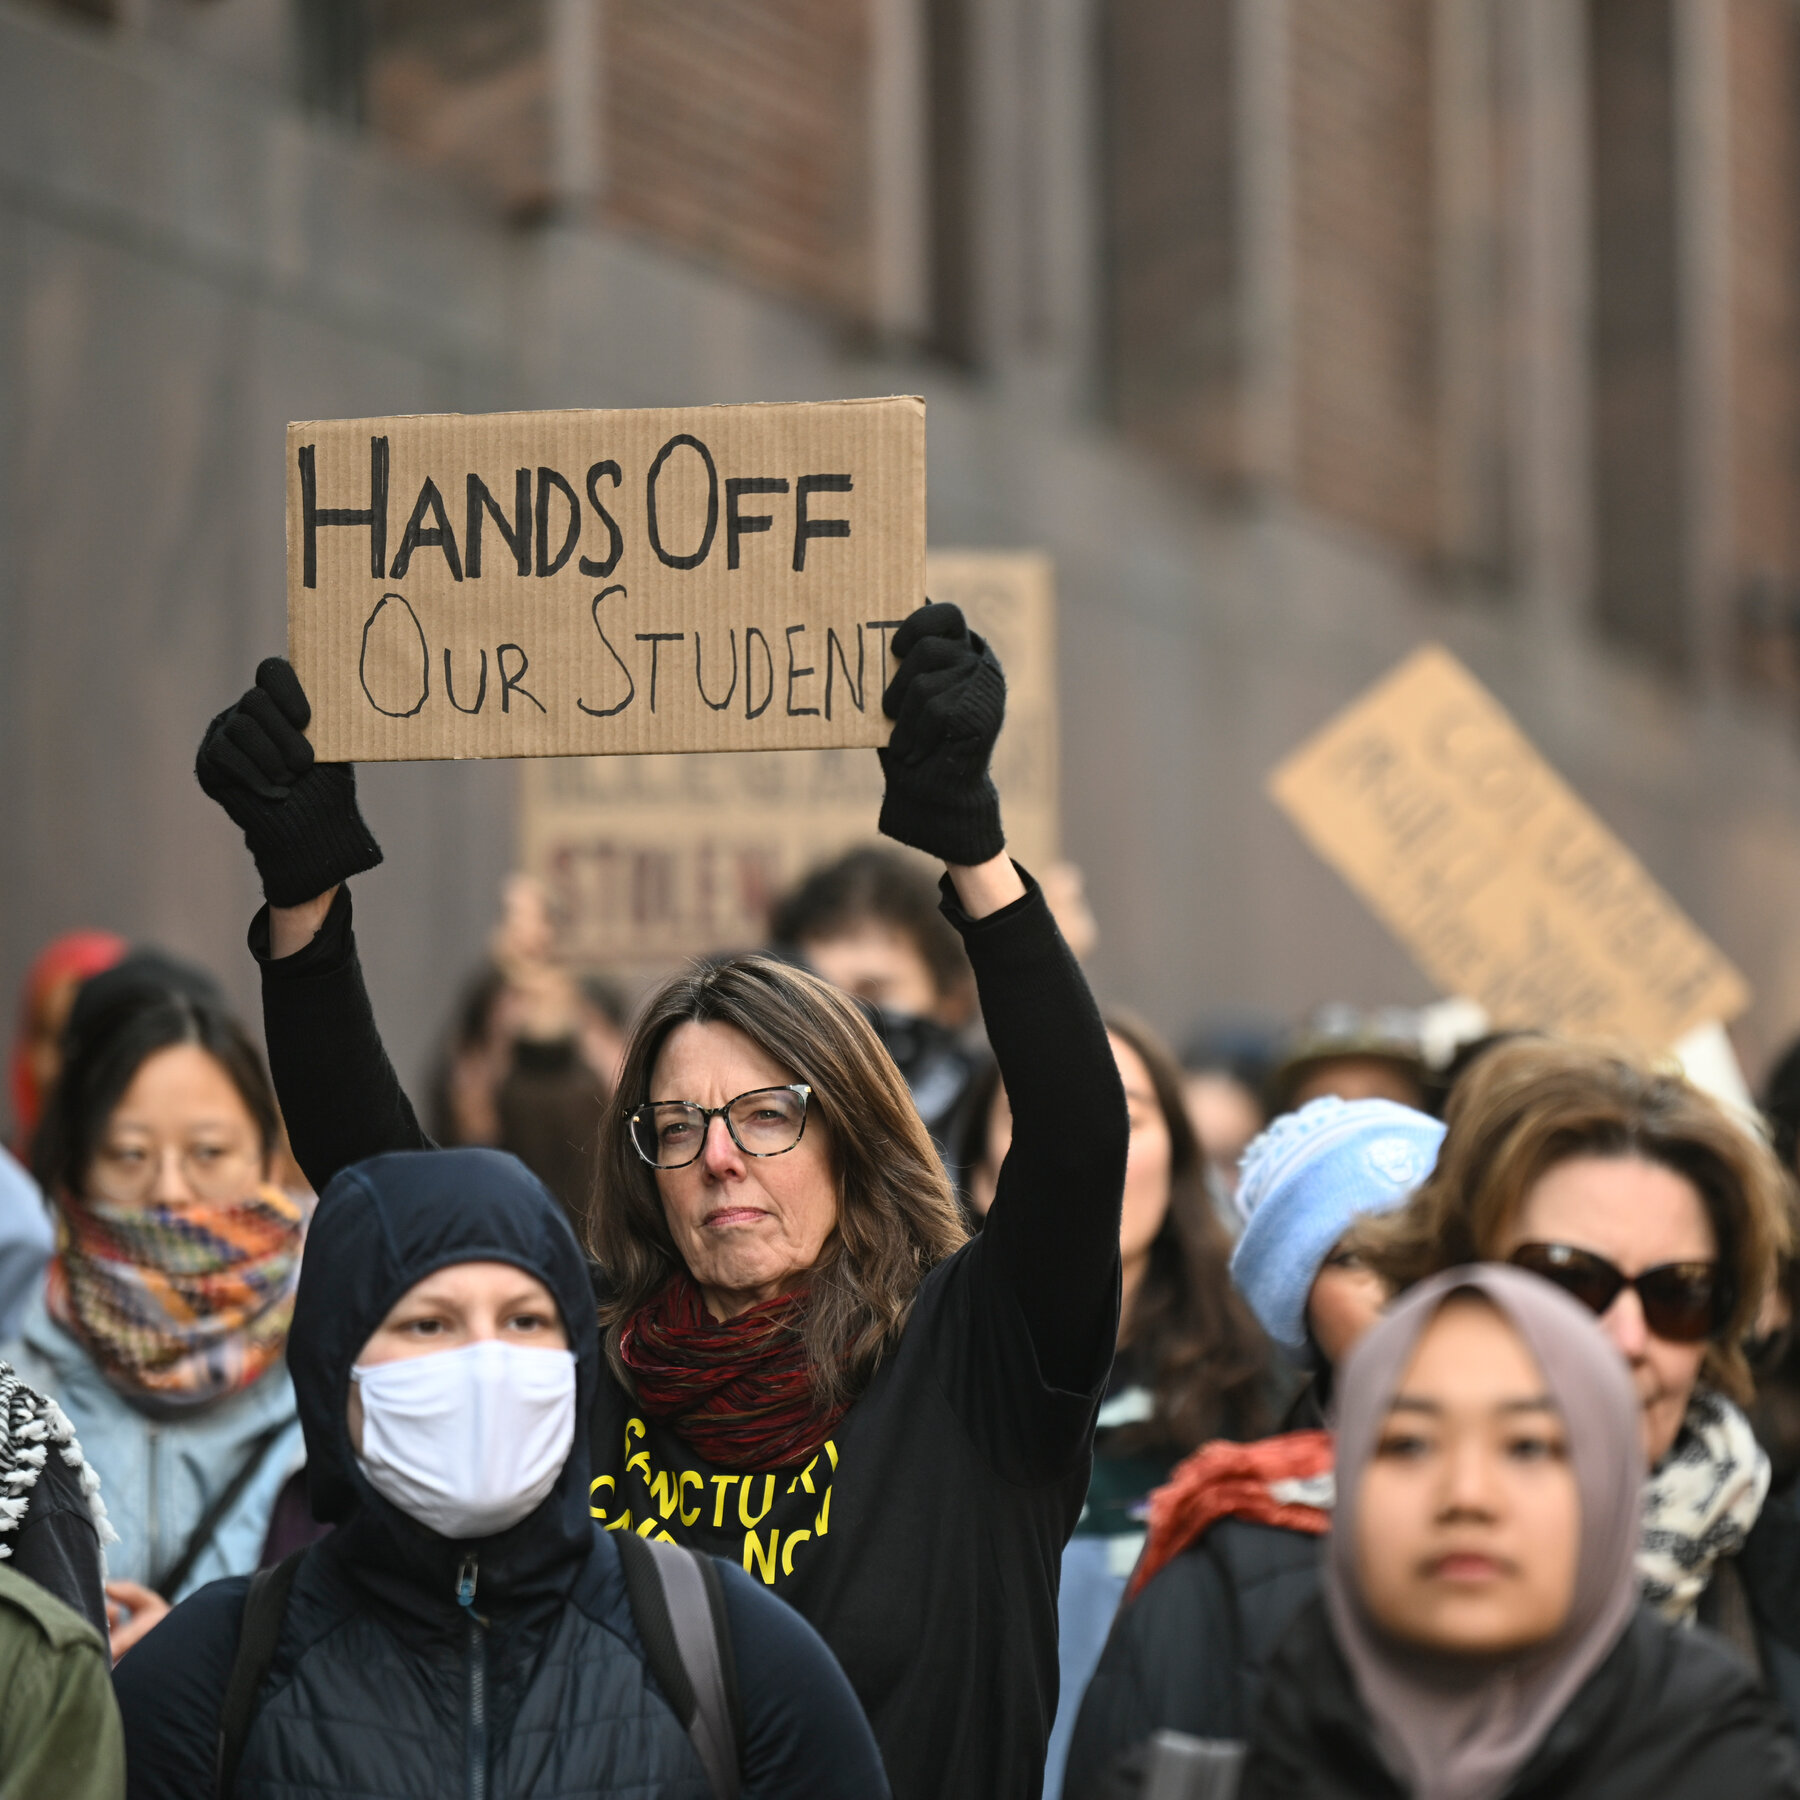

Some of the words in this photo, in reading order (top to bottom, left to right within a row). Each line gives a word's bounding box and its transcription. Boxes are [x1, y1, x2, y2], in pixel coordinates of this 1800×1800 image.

[298, 434, 623, 588] HANDS
[647, 434, 853, 571] OFF
[359, 592, 546, 718] OUR
